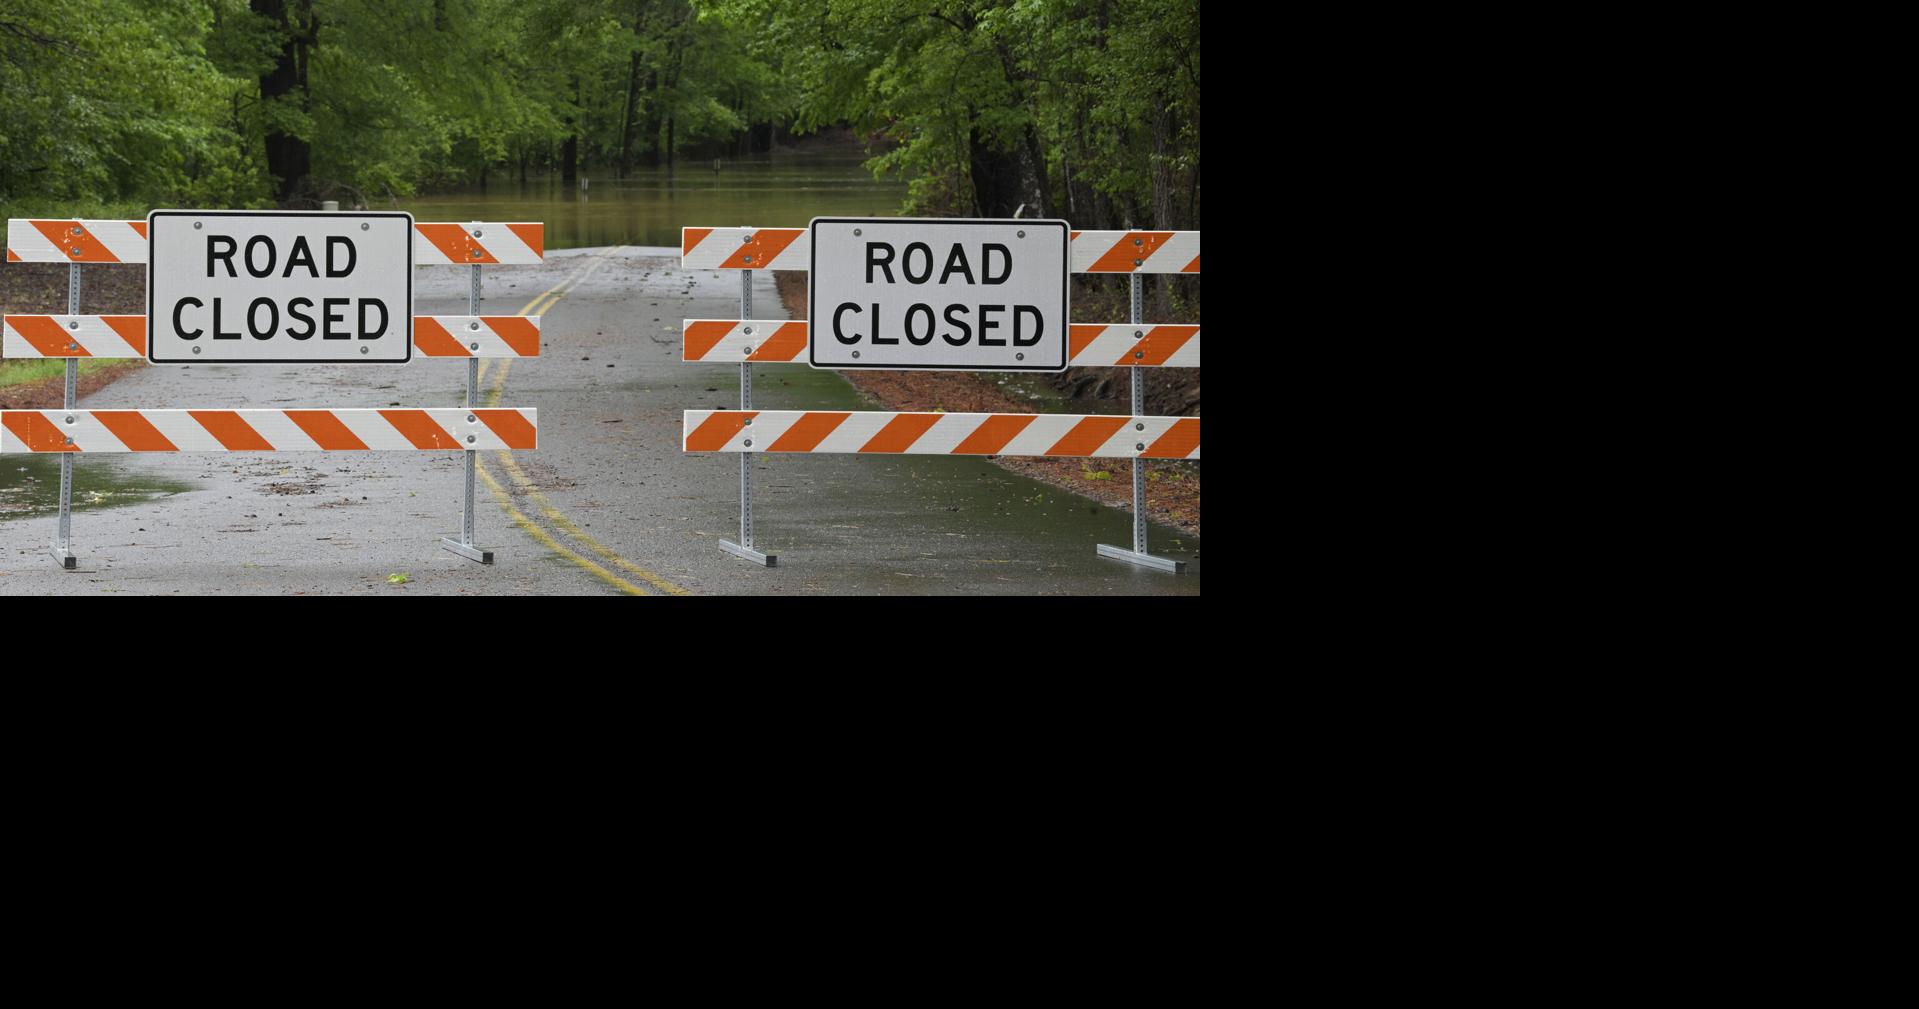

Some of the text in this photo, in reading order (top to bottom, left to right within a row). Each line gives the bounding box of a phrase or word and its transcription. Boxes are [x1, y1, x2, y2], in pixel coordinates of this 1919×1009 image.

[206, 234, 358, 279] ROAD
[865, 241, 1013, 286] ROAD
[172, 296, 389, 341] CLOSED
[832, 301, 1045, 347] CLOSED
